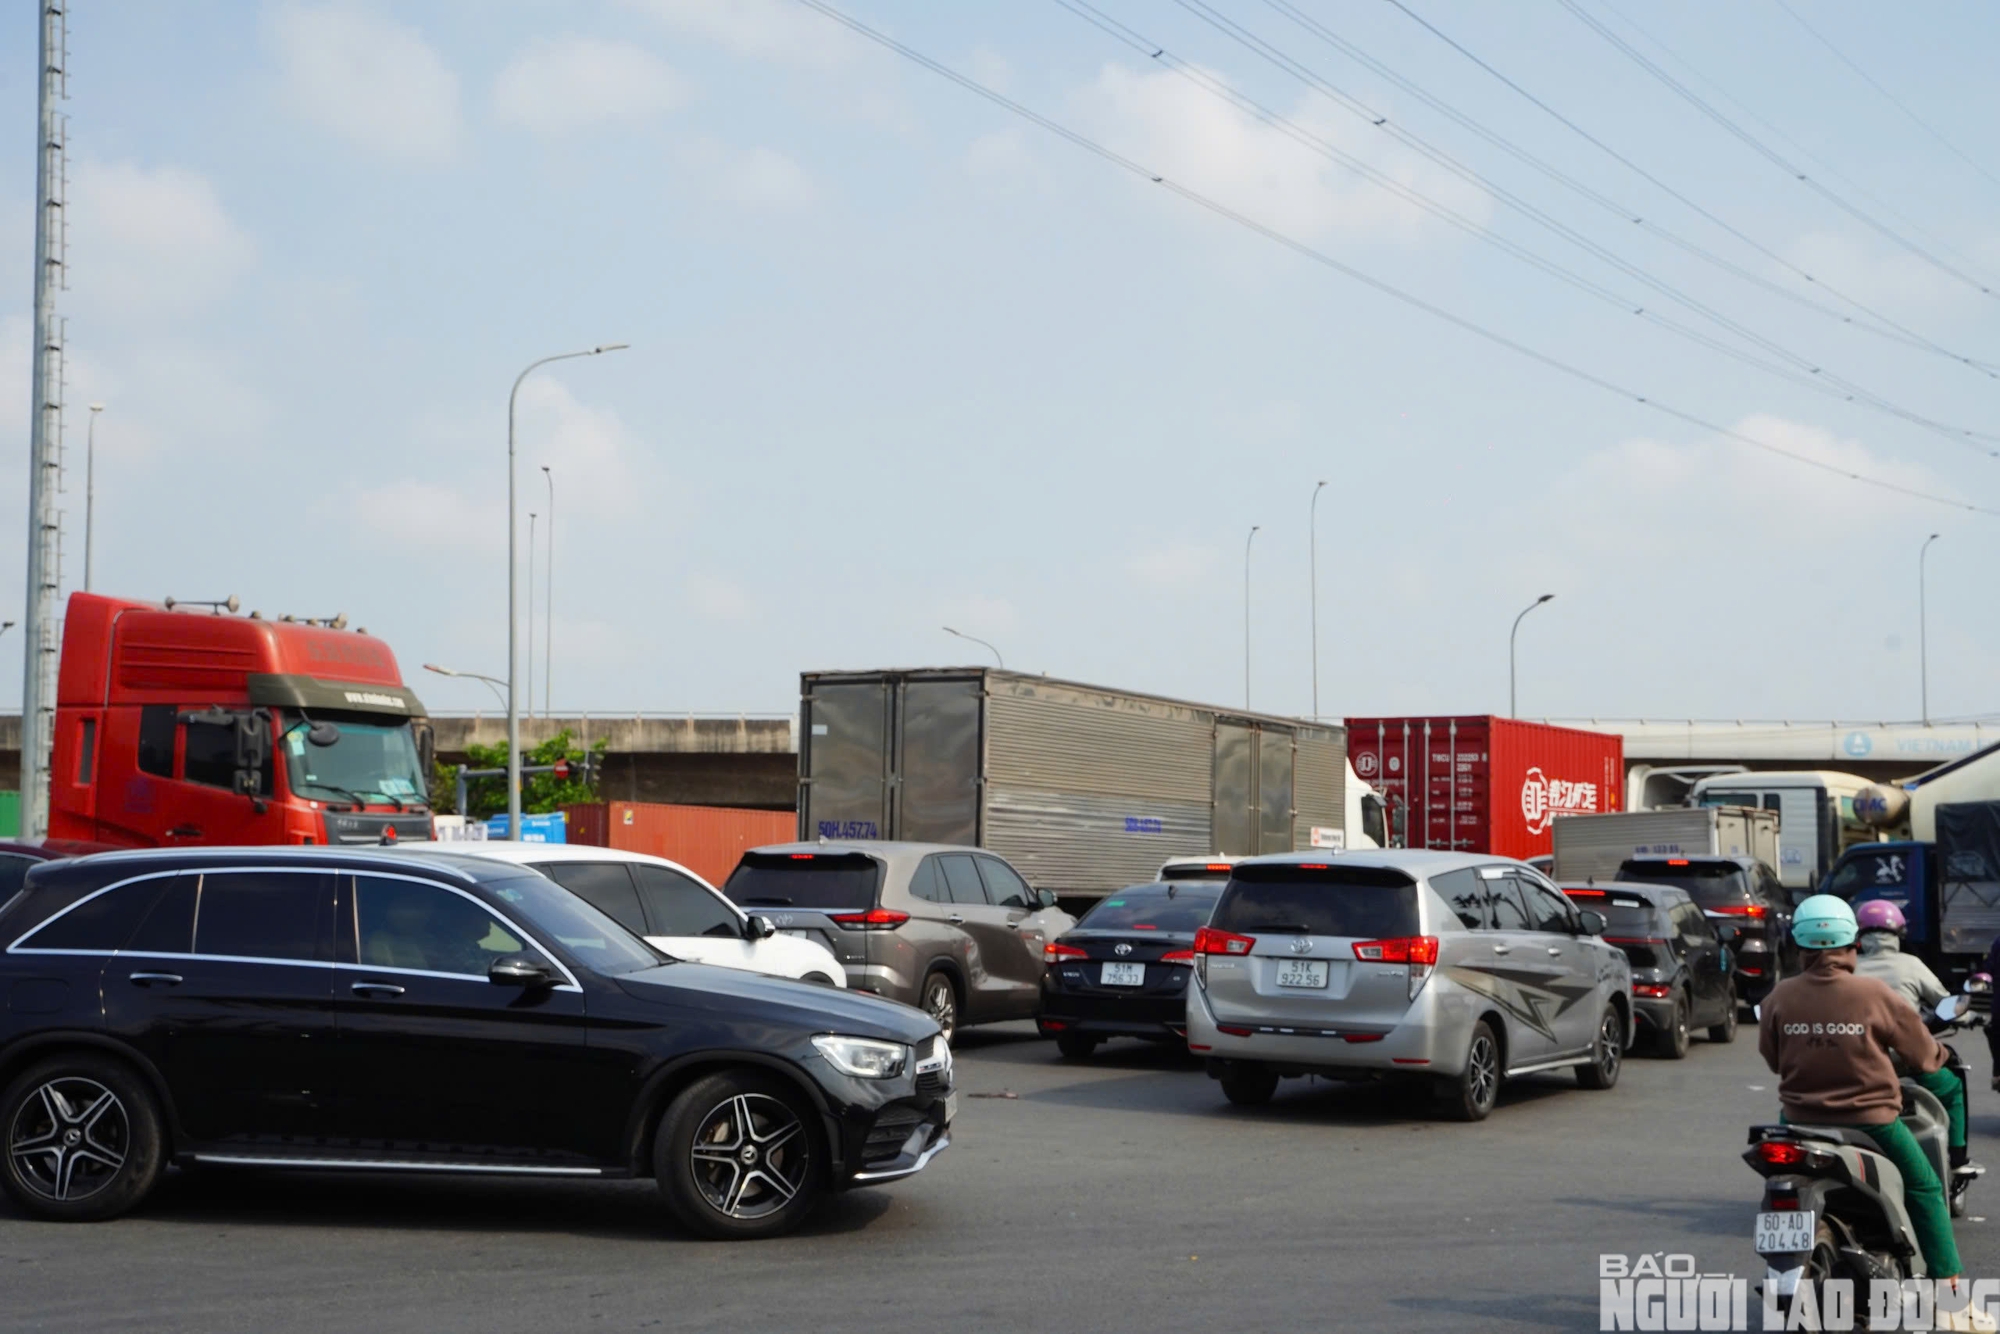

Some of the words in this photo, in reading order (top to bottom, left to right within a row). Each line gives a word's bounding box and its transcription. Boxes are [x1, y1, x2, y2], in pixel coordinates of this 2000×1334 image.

[1895, 738, 1972, 751] VIETNAM
[1291, 961, 1312, 973] 51K
[1281, 973, 1320, 986] 922.56
[1784, 1023, 1809, 1035] GOD
[1812, 1023, 1823, 1034] IS
[1826, 1023, 1865, 1035] GOOD
[1758, 1232, 1810, 1250] 204.48
